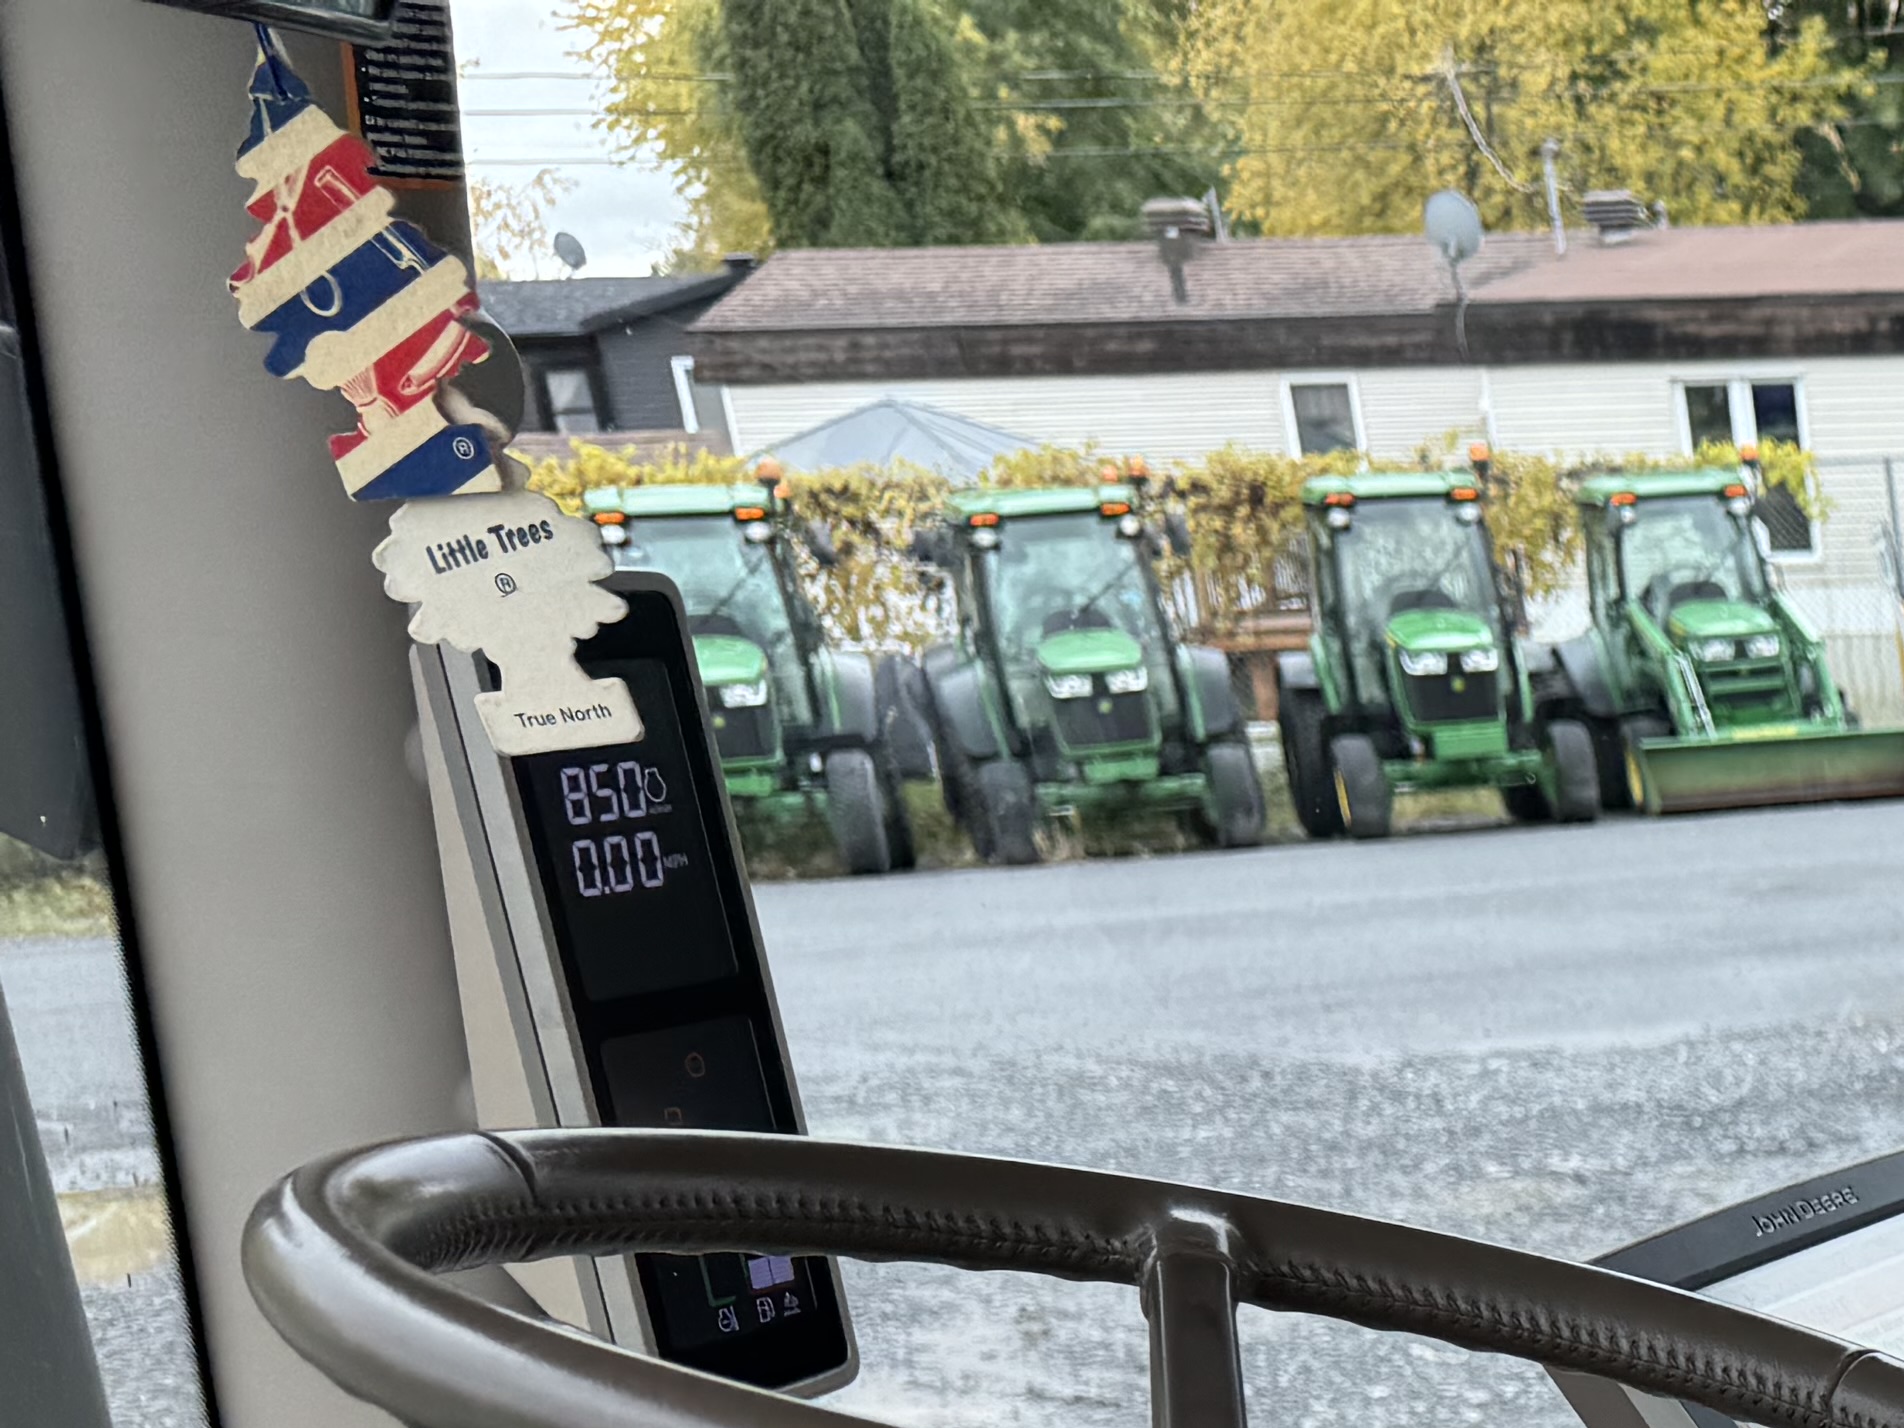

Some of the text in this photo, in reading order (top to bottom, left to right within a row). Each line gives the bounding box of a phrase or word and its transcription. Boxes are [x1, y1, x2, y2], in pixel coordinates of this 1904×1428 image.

[425, 519, 554, 574] Little Trees
[514, 703, 612, 728] True North
[560, 760, 647, 825] 850
[572, 831, 664, 897] 0.00
[1752, 1185, 1859, 1237] JOHN DEERE
